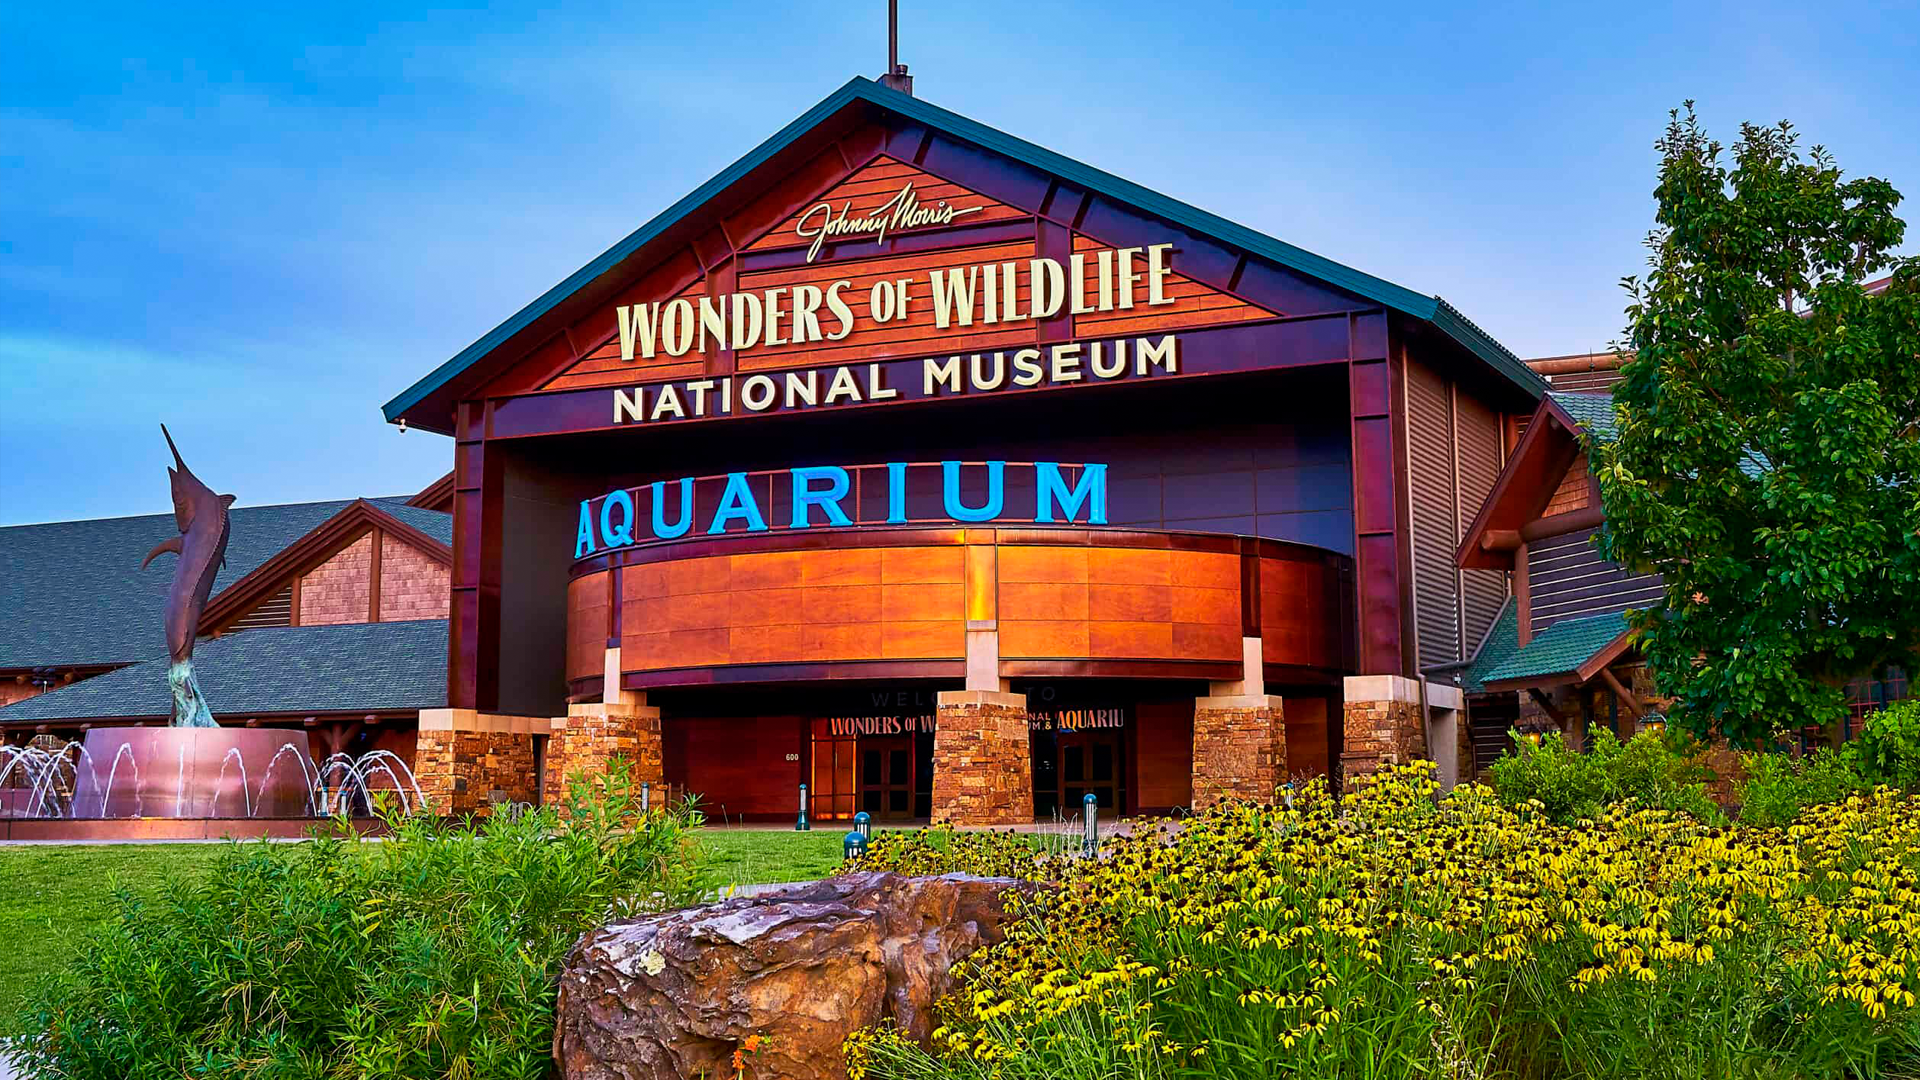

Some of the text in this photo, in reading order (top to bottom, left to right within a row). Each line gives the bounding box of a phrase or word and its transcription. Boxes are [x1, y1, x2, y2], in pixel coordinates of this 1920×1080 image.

[796, 182, 983, 263] Johnny Morris
[616, 243, 1175, 361] WONDERS OF WILDLIFE
[613, 335, 1177, 423] NATIONAL MUSEUM
[574, 461, 1109, 559] AQUARIUM
[785, 753, 799, 761] 600
[830, 716, 902, 736] WONDERS
